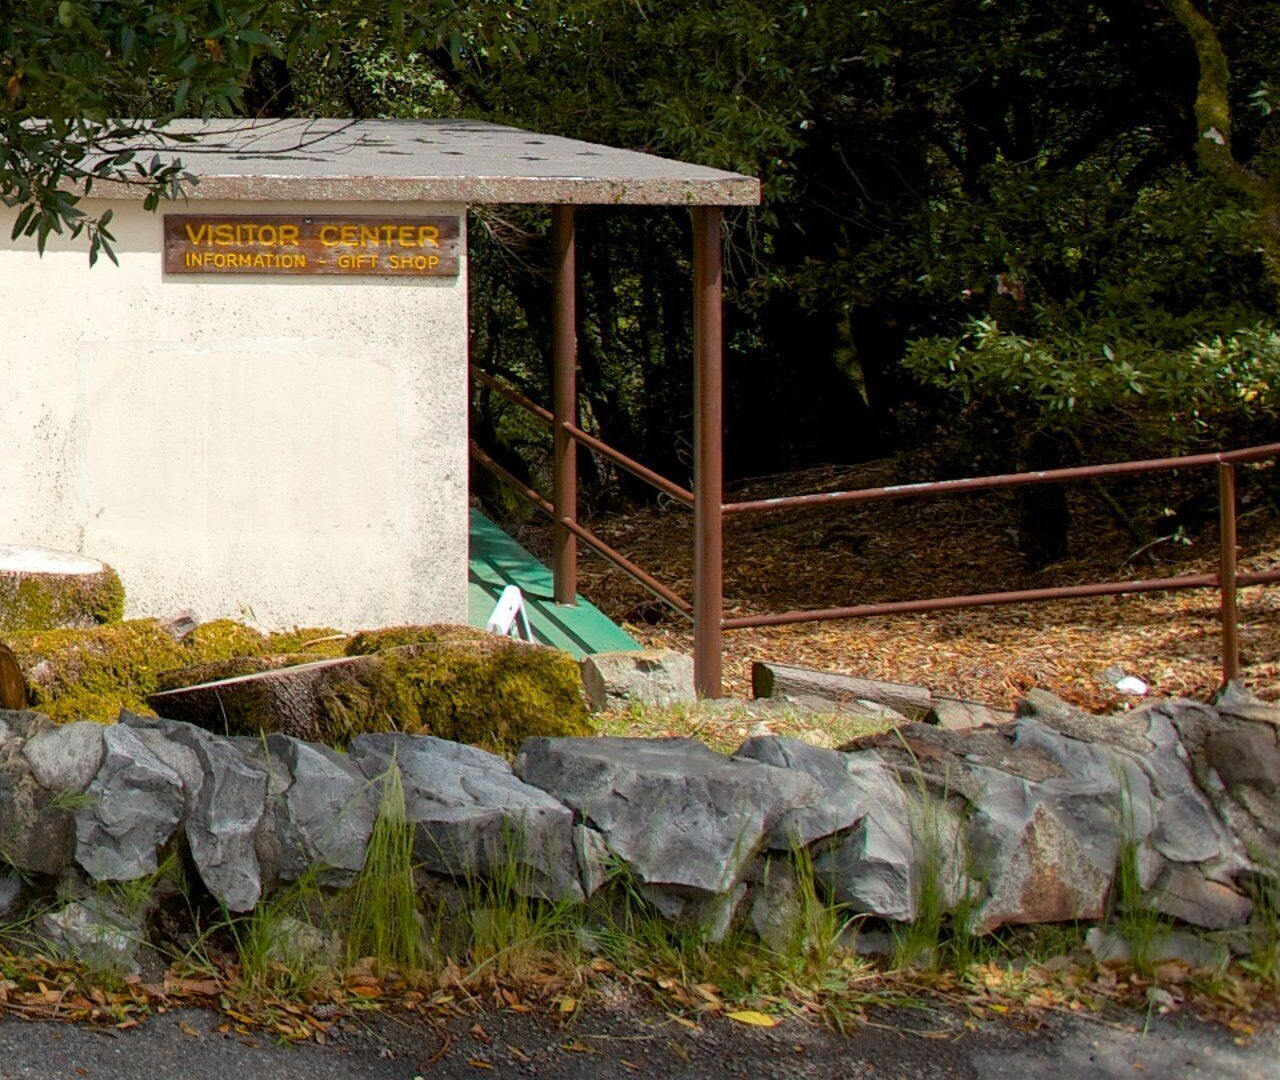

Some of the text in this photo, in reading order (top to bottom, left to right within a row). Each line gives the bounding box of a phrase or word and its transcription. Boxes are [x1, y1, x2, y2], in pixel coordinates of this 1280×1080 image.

[185, 223, 440, 248] VISITOR CENTER
[185, 252, 307, 268] INFORMATION
[337, 253, 379, 269] GIFT
[389, 254, 440, 270] SHOP
